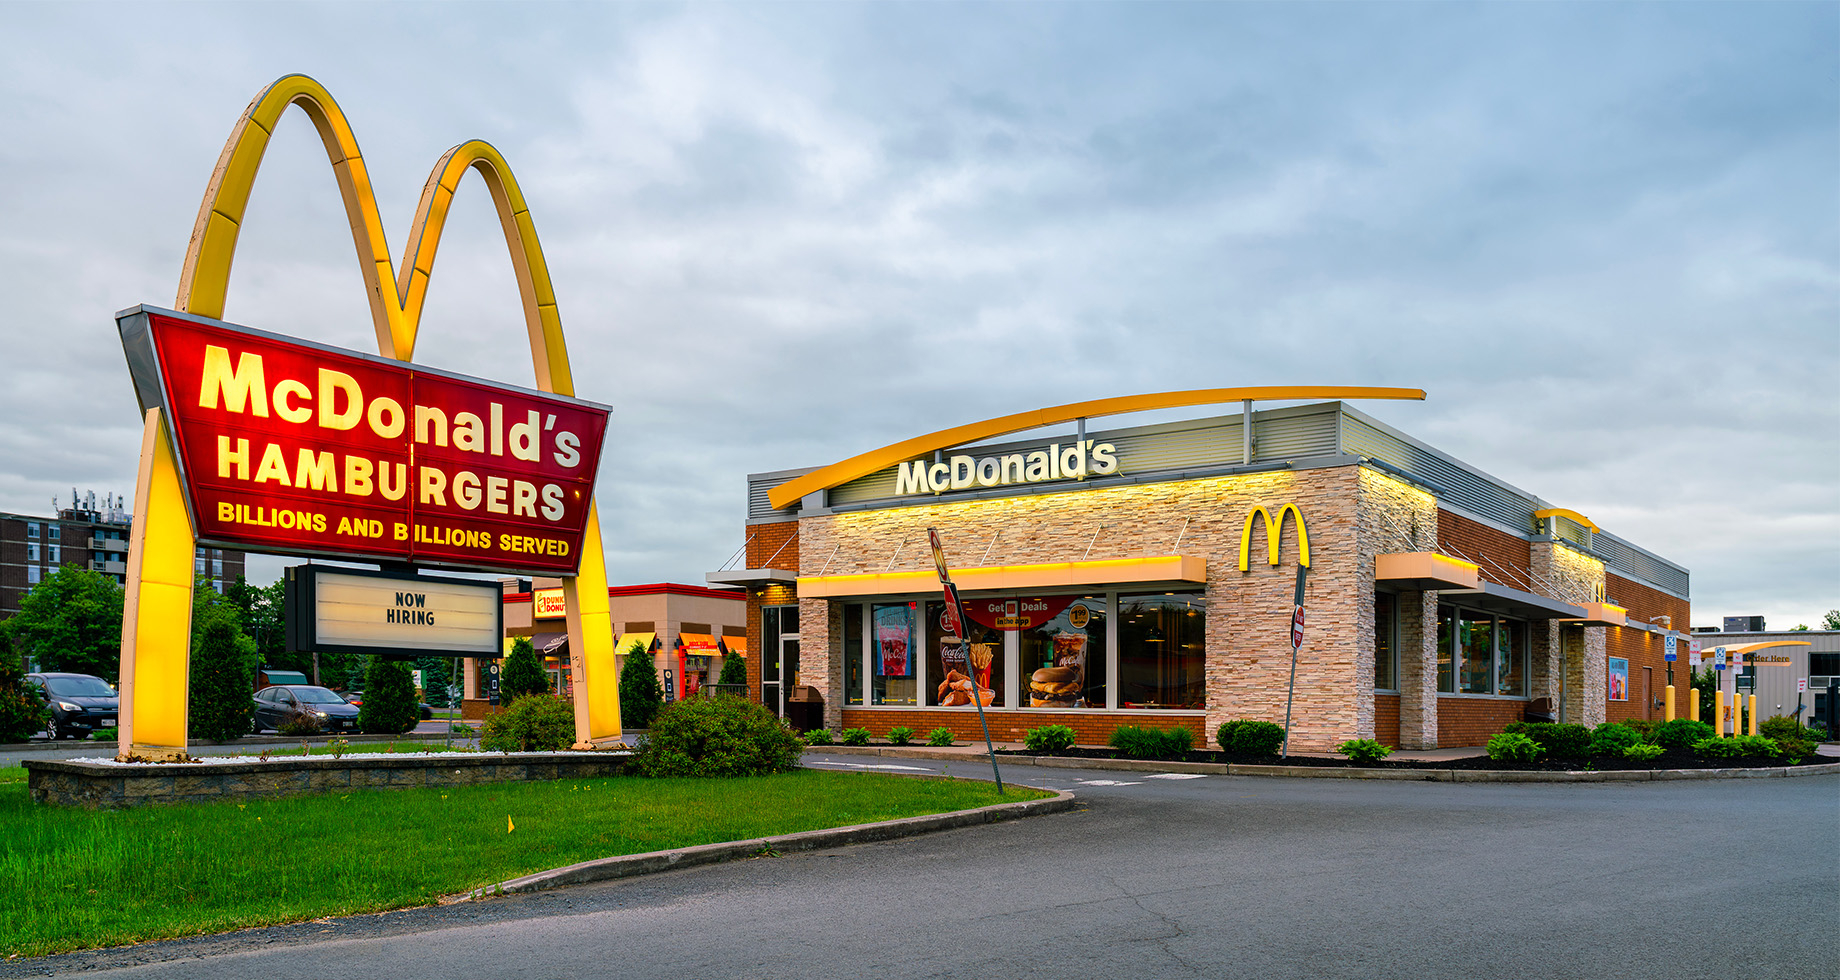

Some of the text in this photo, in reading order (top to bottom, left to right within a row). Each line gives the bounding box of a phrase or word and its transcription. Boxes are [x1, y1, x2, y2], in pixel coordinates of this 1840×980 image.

[198, 344, 582, 468] McDonald's
[895, 439, 1118, 496] McDonald's
[217, 435, 566, 521] HAMBURGERS
[217, 501, 570, 557] BILLIONS AND BILLIONS SERVED
[395, 591, 426, 608] NOW
[546, 596, 564, 604] DUNK
[546, 604, 566, 612] DONU
[988, 601, 1048, 613] Get Deals
[386, 609, 435, 627] HIRING
